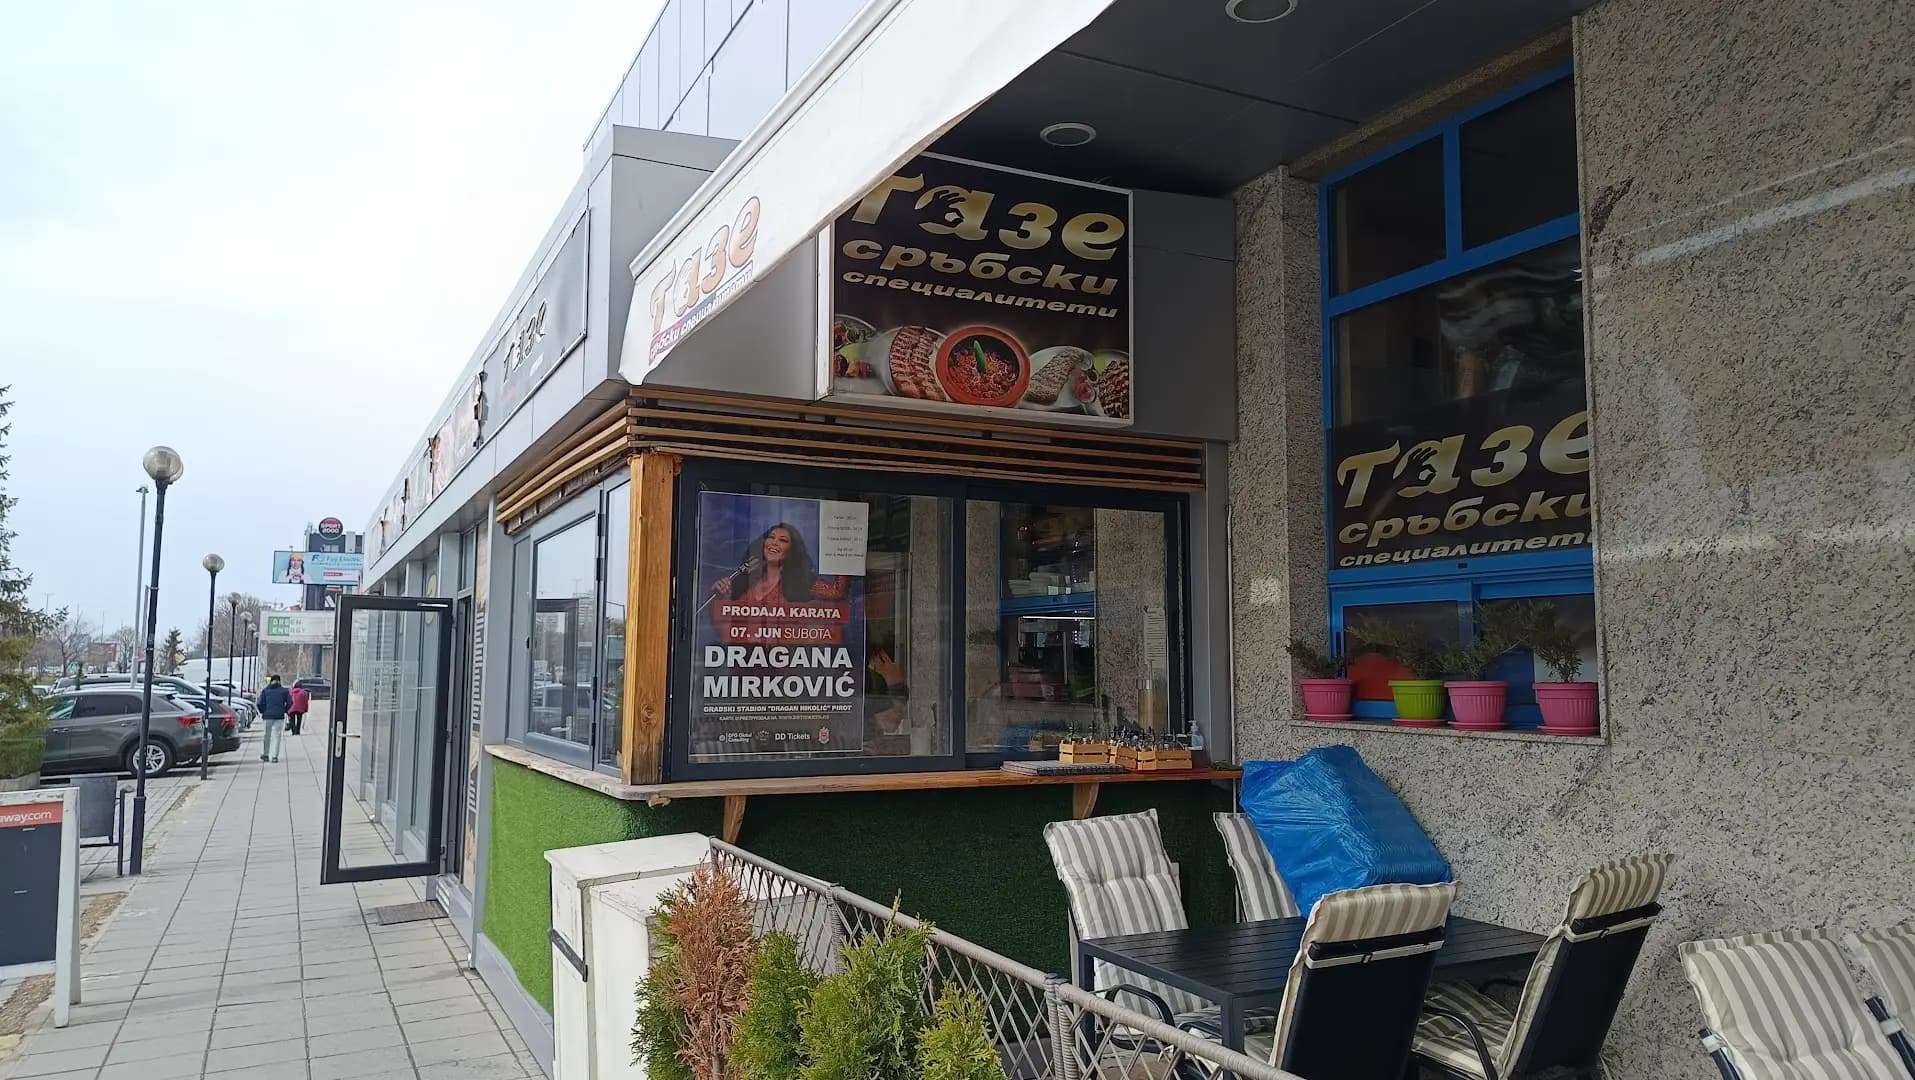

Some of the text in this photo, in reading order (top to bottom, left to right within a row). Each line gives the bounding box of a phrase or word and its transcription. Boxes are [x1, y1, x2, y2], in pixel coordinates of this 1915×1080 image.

[842, 240, 1118, 296] сръбски
[842, 271, 1118, 319] специалитети
[1339, 531, 1594, 568] специалитет
[722, 605, 841, 619] PRODAJA KARATA
[730, 627, 832, 640] 07. JUN SUBOTA
[704, 645, 853, 668] DRAGANA
[703, 671, 855, 698] MIRKOVIĆ
[774, 733, 786, 741] DD
[787, 732, 811, 740] Tickets
